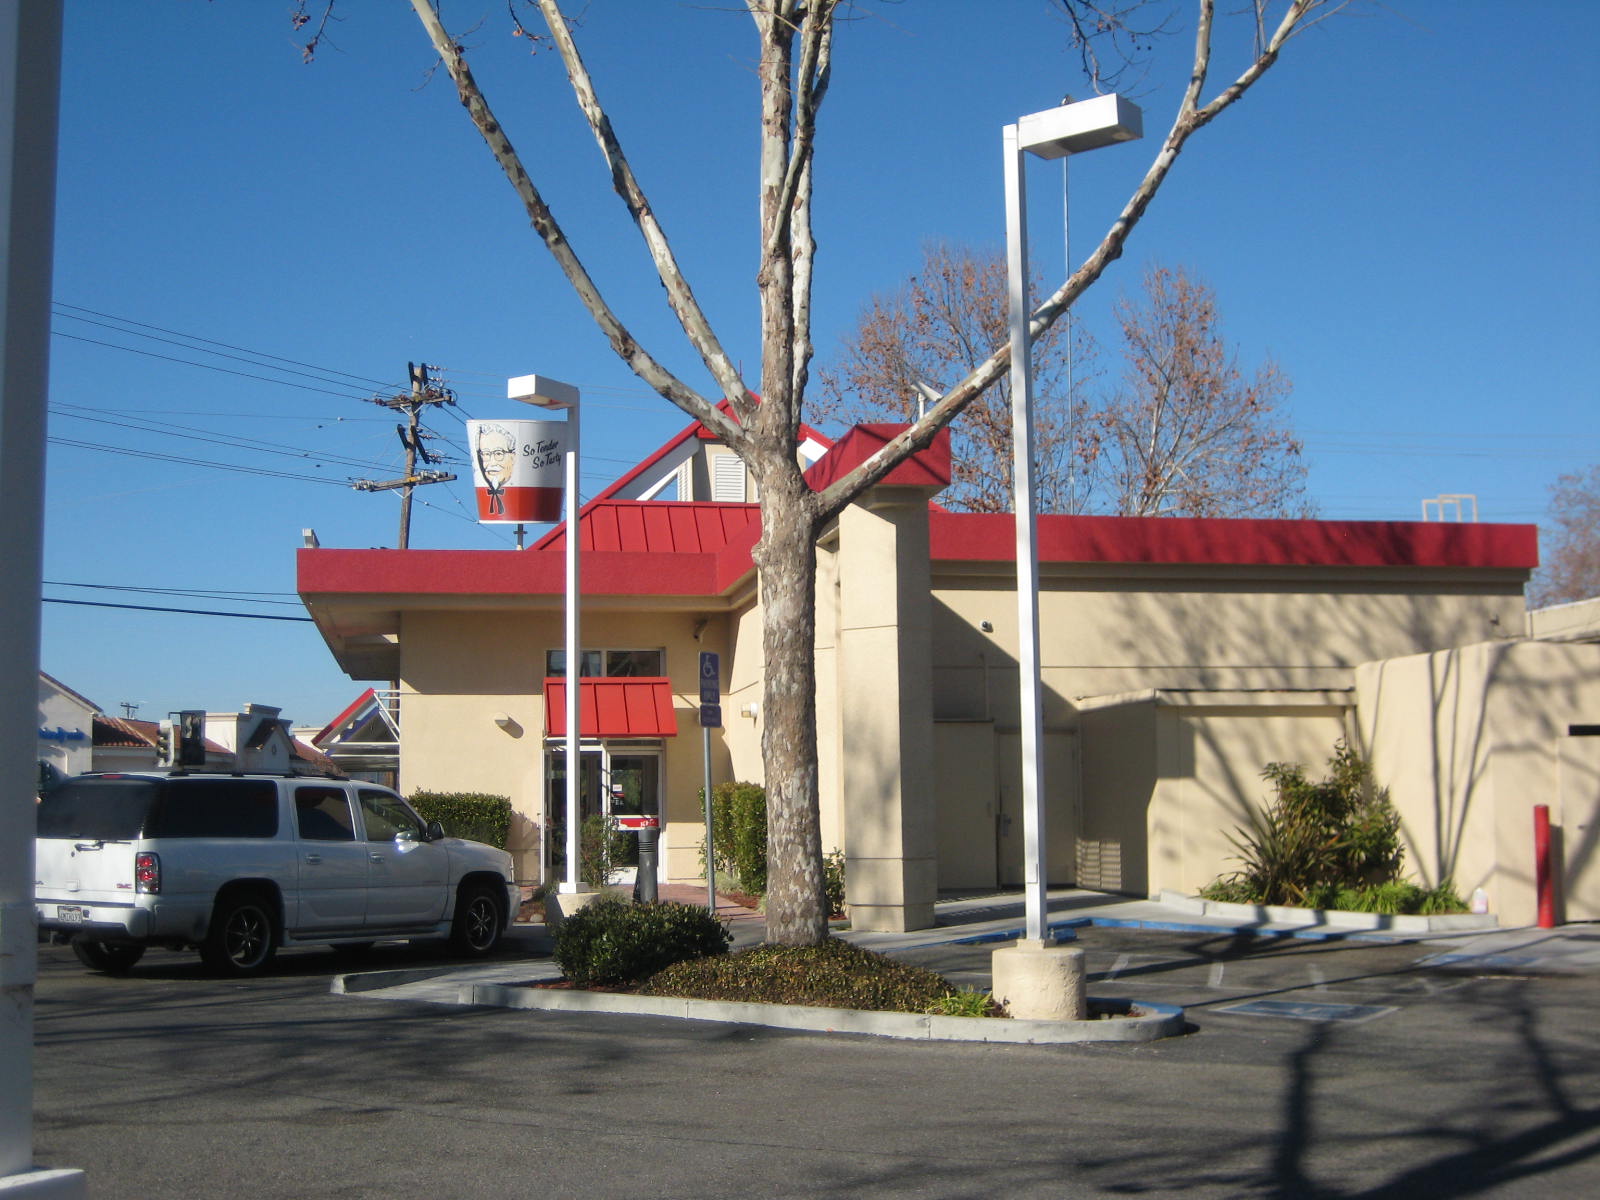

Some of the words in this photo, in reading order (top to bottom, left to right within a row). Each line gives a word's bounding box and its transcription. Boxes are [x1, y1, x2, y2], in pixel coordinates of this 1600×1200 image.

[523, 444, 535, 456] So
[536, 440, 559, 453] Tender
[532, 456, 545, 469] So
[545, 452, 562, 466] Tasty
